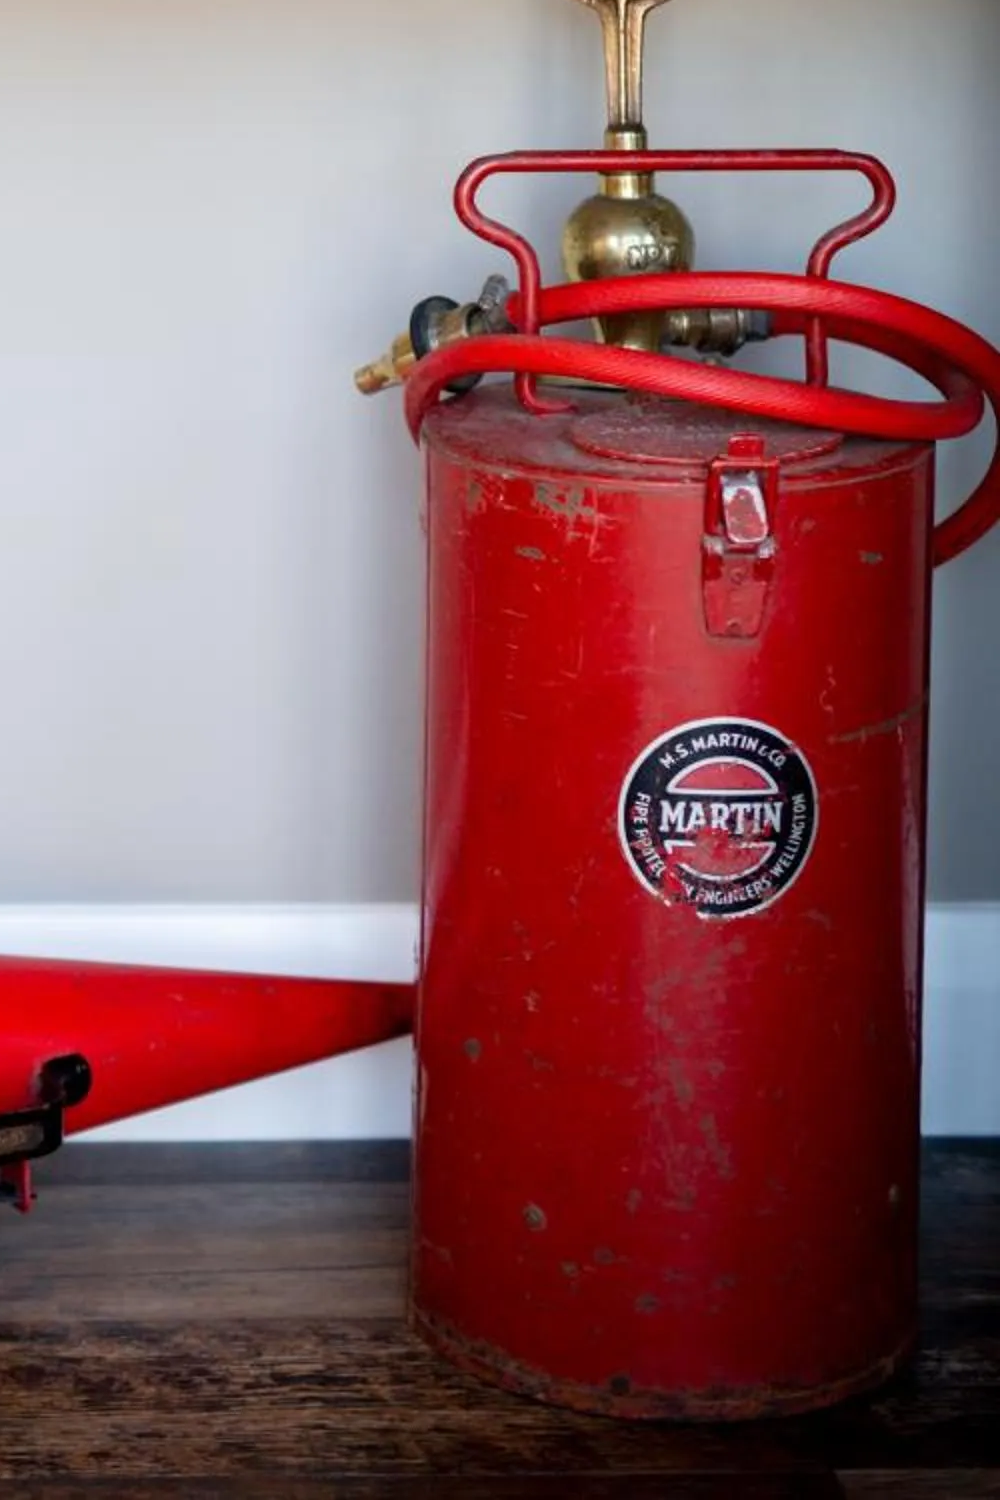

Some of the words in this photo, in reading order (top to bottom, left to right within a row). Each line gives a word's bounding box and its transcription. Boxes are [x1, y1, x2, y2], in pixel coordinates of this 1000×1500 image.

[691, 733, 759, 753] MARTIN
[659, 800, 784, 835] MARTIN
[769, 793, 807, 878] WELLINGTON
